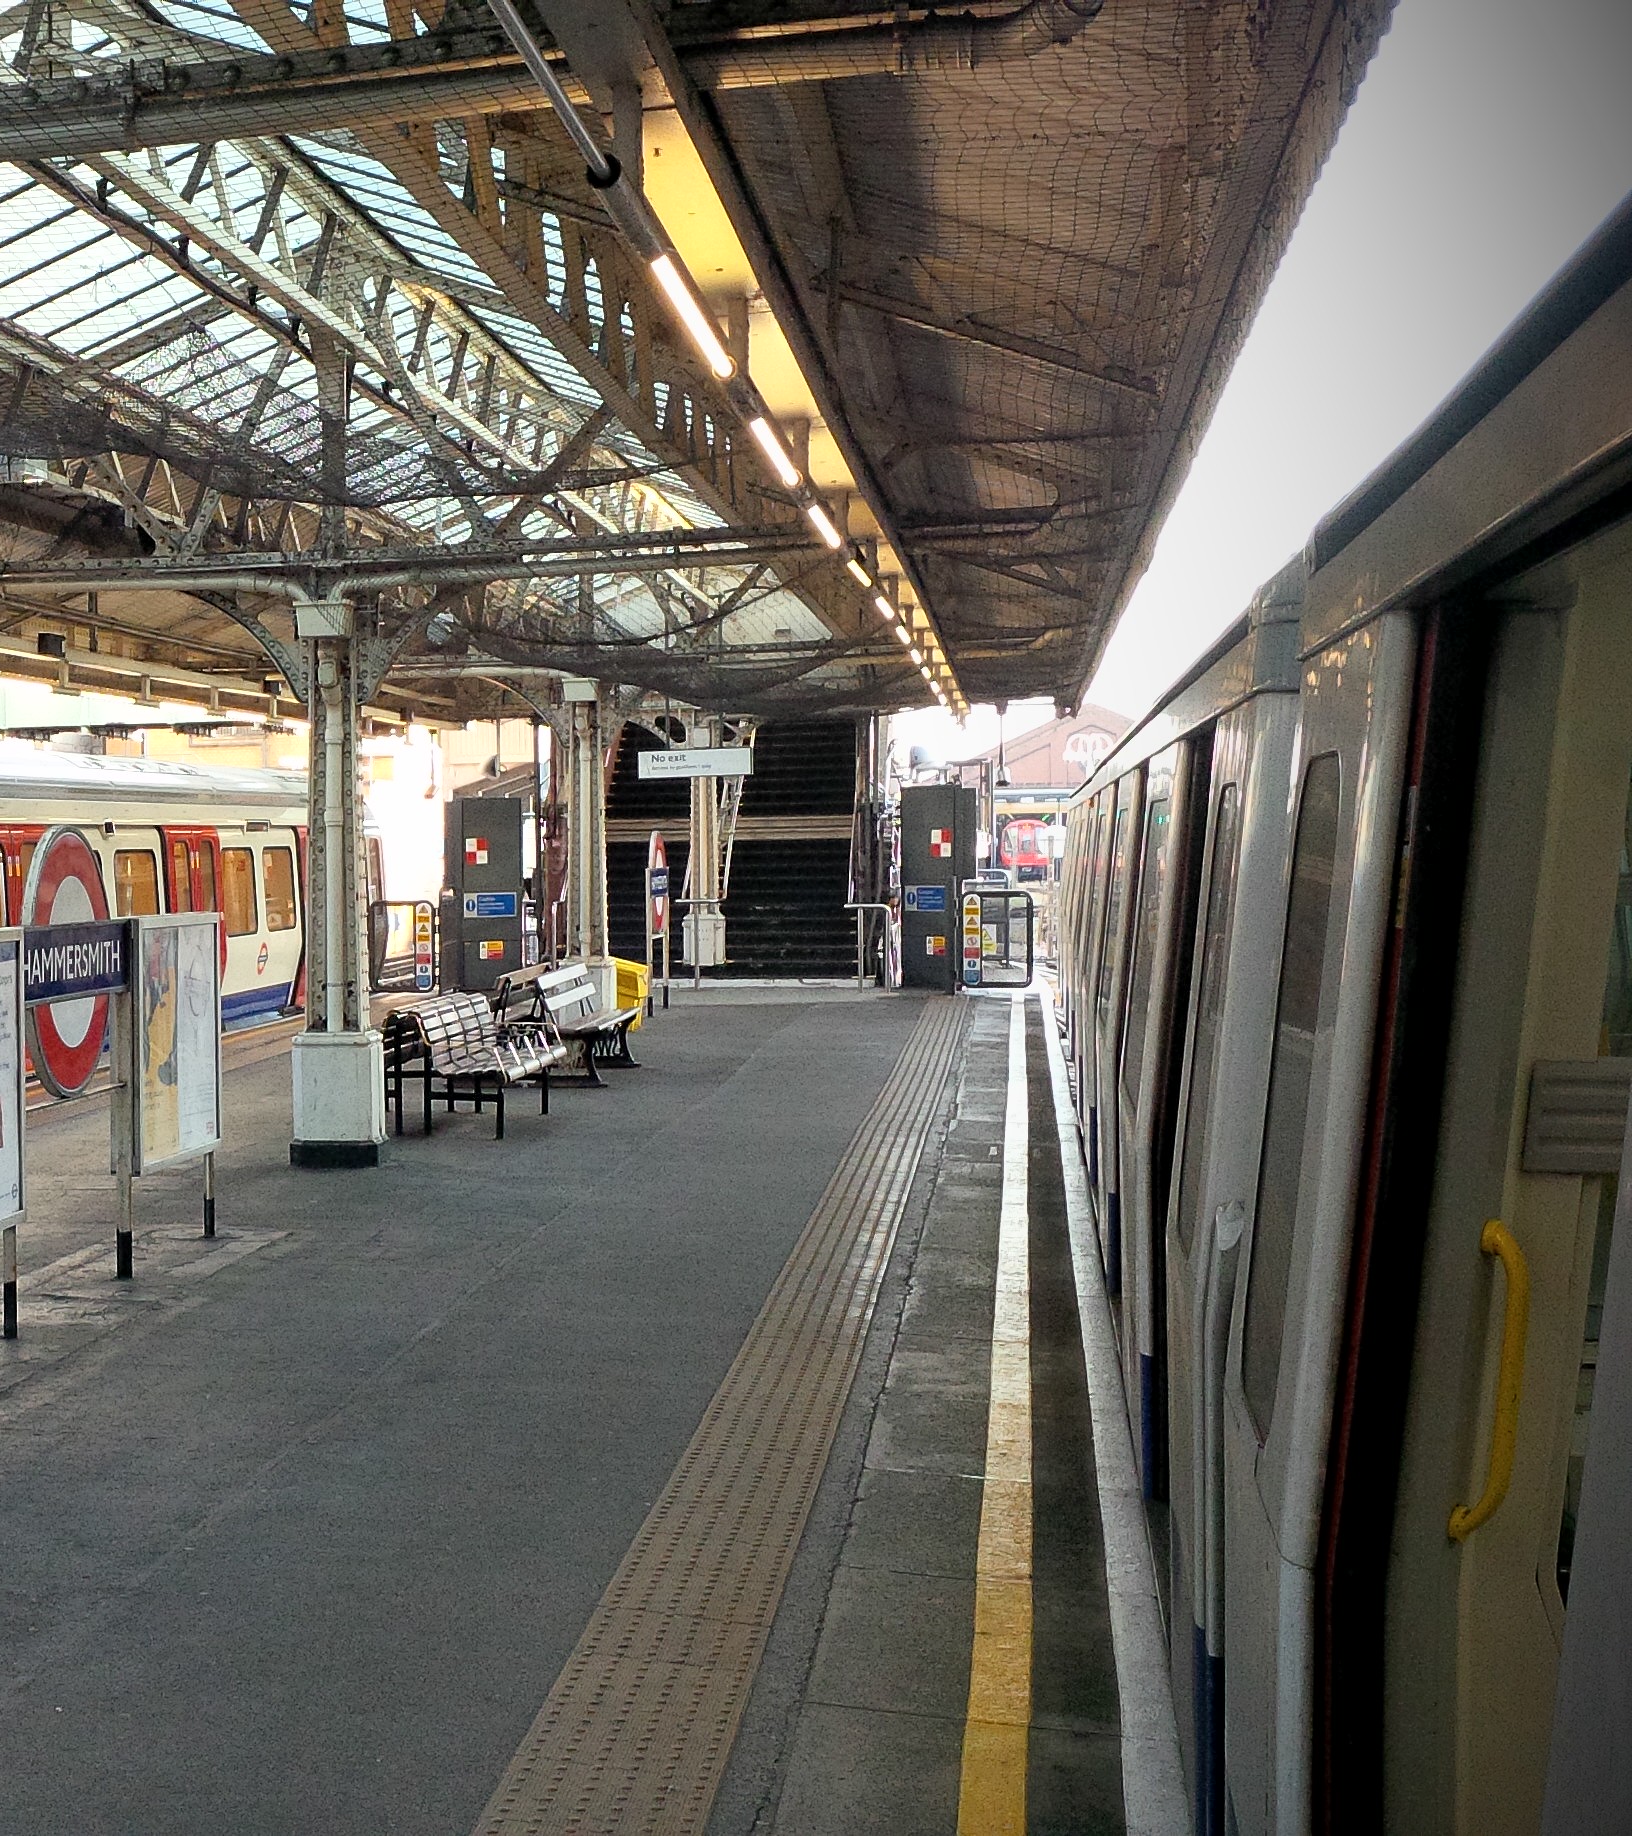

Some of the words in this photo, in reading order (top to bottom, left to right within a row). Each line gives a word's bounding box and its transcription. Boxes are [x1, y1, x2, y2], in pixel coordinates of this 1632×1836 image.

[651, 754, 665, 763] No
[668, 753, 686, 762] exit
[23, 940, 120, 985] HAMMERSMITH
